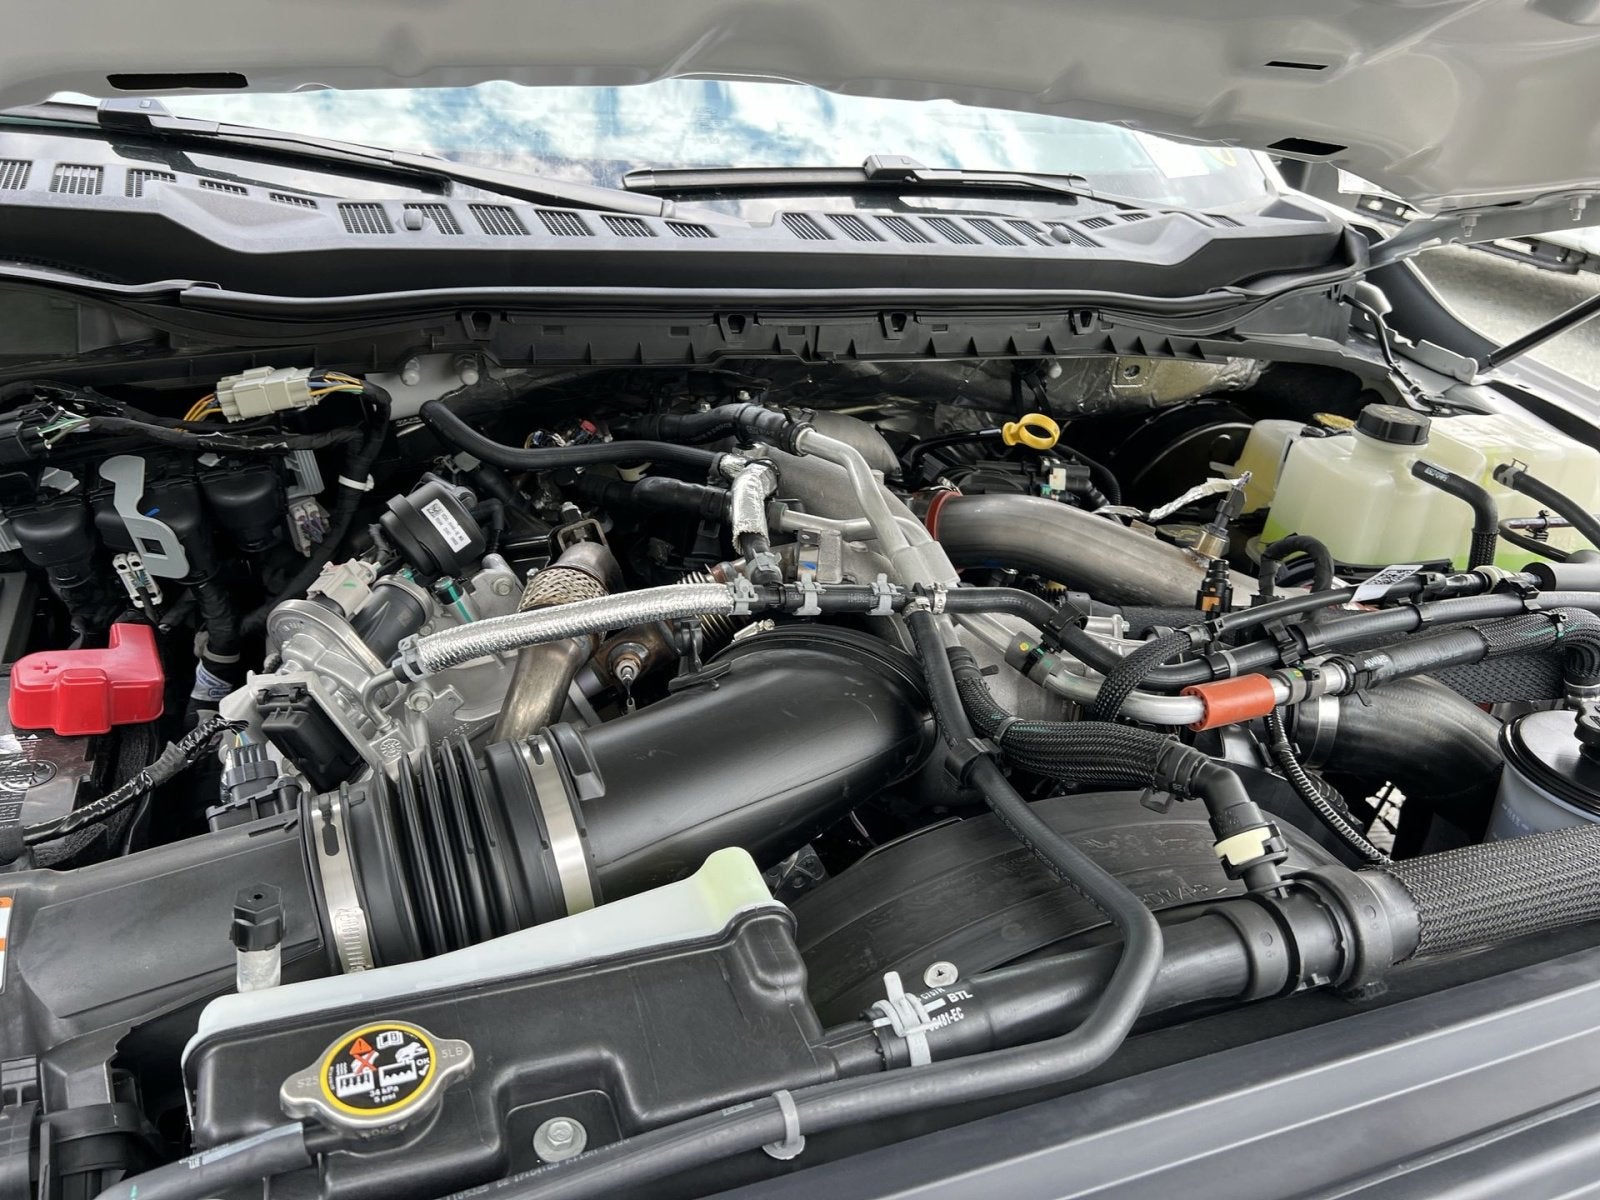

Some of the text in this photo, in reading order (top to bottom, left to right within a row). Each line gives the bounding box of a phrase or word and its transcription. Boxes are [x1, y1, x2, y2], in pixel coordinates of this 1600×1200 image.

[946, 990, 974, 1003] BTL
[416, 1057, 430, 1066] OK
[369, 1085, 400, 1098] 34 kPa
[381, 1093, 397, 1103] psi
